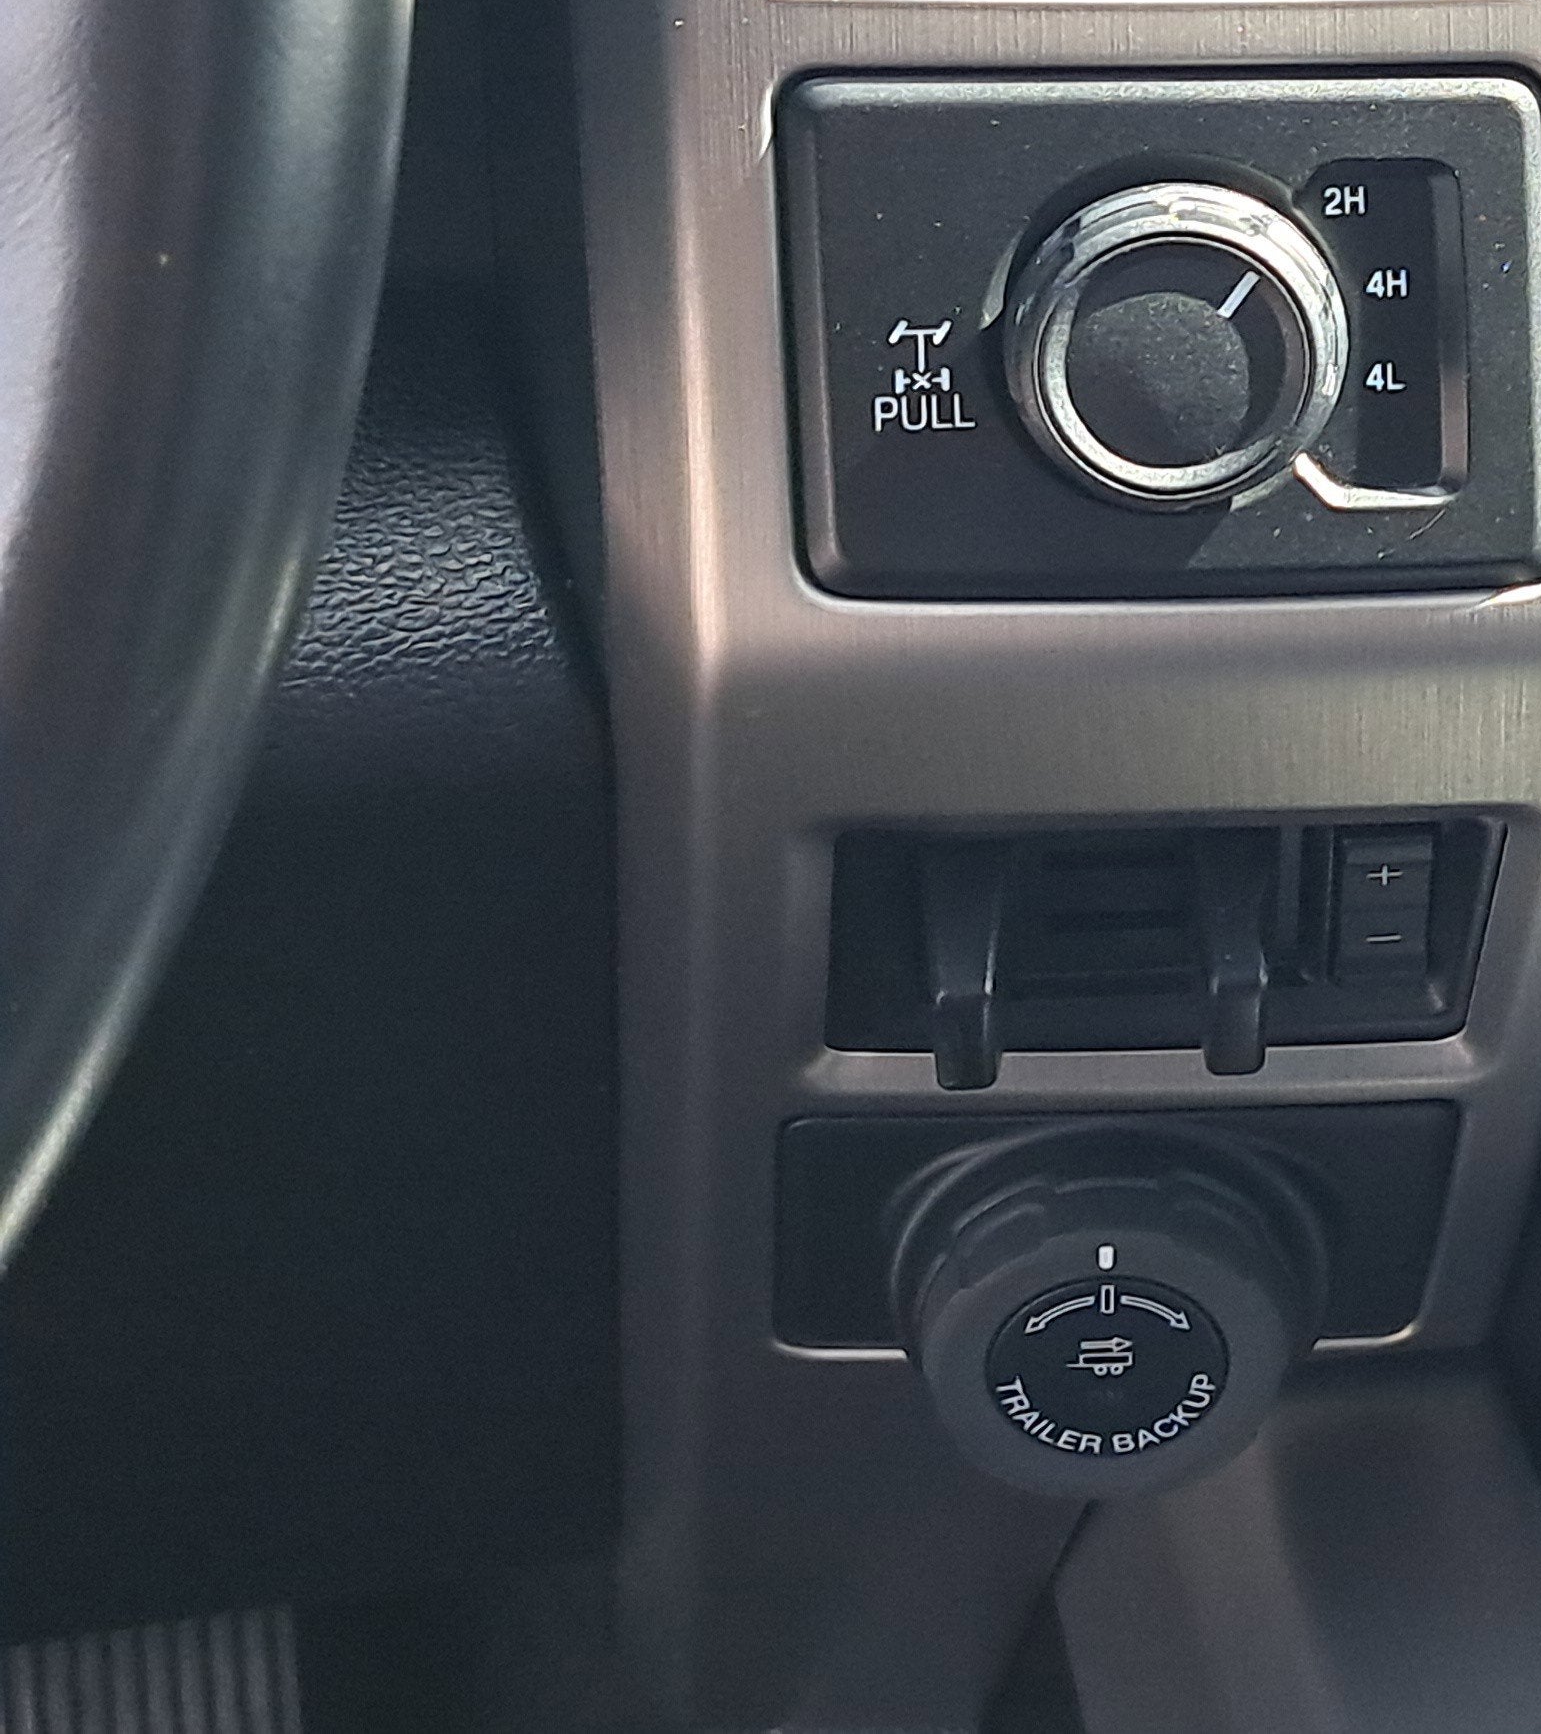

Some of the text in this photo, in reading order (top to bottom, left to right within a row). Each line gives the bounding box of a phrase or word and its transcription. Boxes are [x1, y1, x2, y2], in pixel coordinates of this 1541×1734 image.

[1324, 187, 1365, 216] 2H
[1366, 269, 1408, 298] 4H
[1366, 362, 1405, 391] 4L
[874, 398, 975, 432] PULL
[996, 1373, 1216, 1454] TRAILER BACKUP
